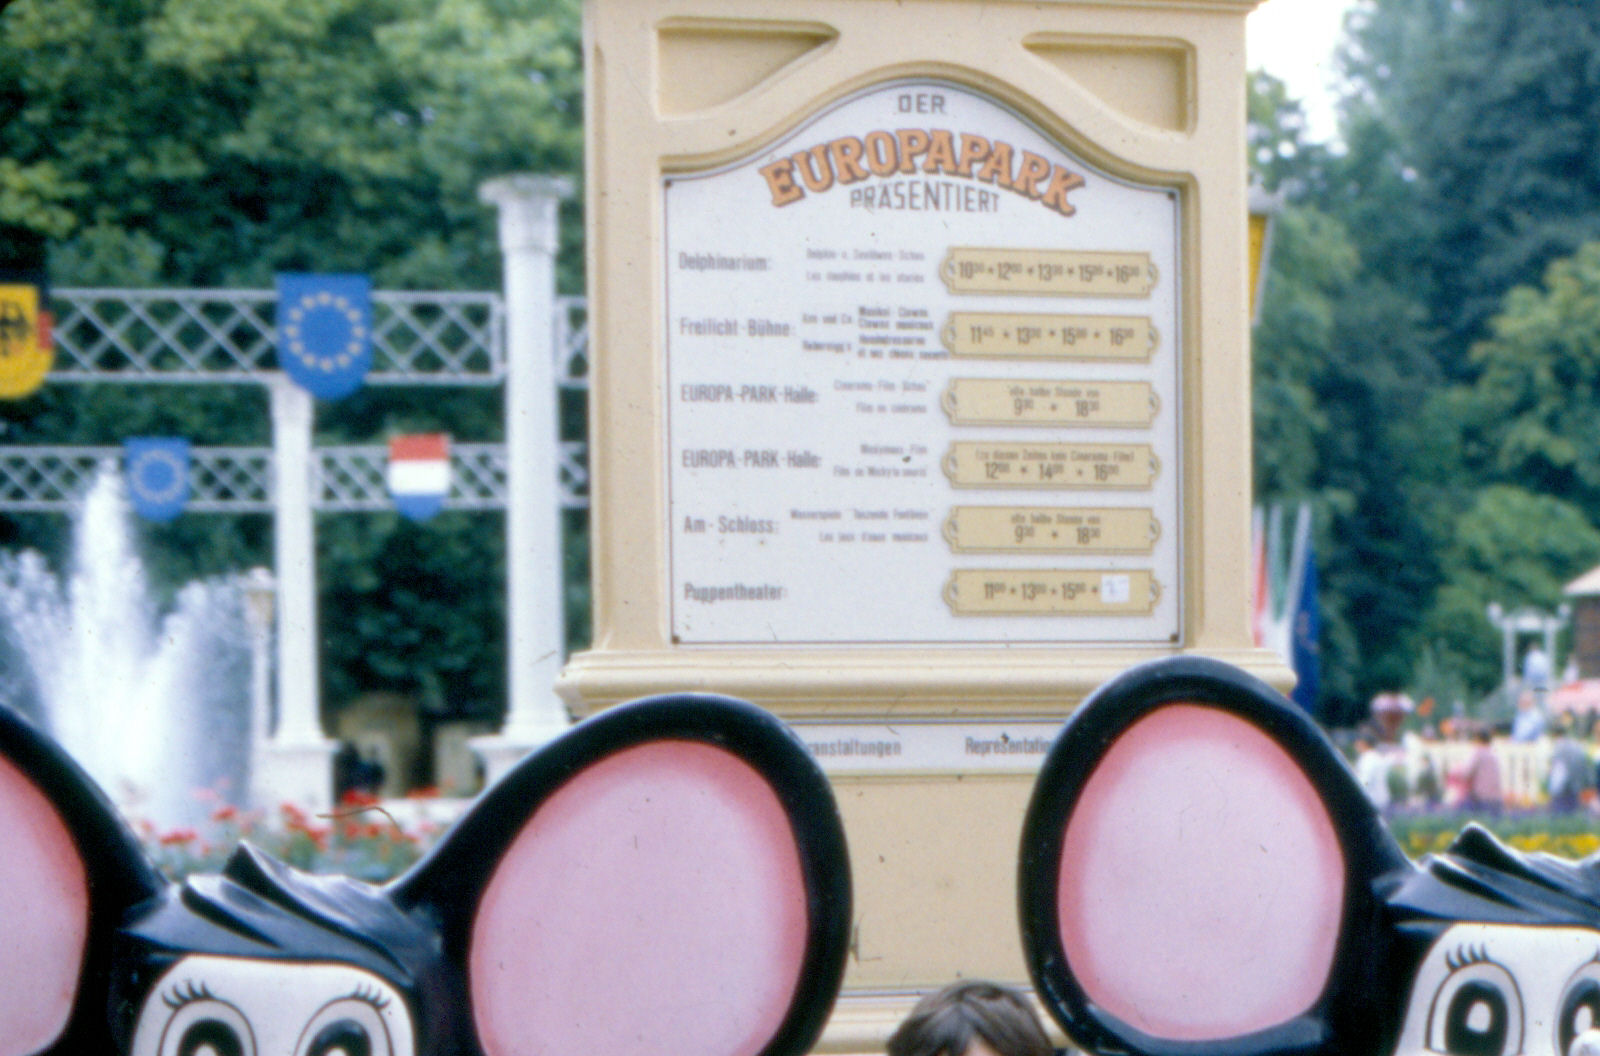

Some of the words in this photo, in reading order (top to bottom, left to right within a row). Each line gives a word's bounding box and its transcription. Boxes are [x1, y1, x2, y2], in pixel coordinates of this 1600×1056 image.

[898, 94, 947, 114] DER
[758, 127, 1086, 217] EUROPAPARK
[850, 180, 1000, 213] PRÄSENTIERT
